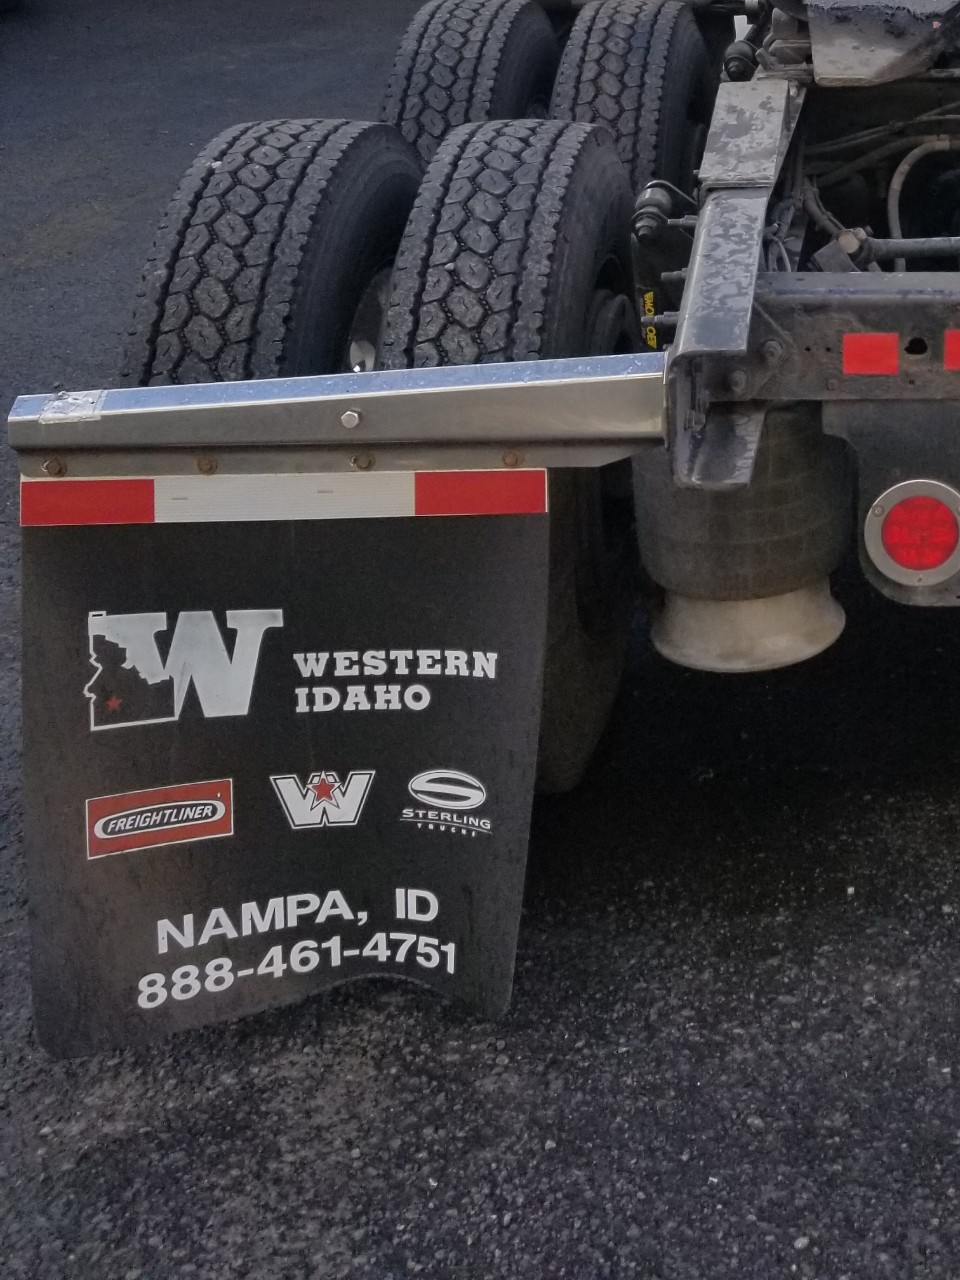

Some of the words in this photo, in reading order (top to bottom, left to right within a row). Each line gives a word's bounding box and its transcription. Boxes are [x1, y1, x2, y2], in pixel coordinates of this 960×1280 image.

[644, 291, 657, 348] MOOE
[292, 649, 498, 680] WESTERN
[294, 684, 431, 713] IDAHO
[107, 805, 214, 834] FREIGHTLINER
[402, 808, 491, 830] STERLING
[156, 889, 368, 954] NAMPA,
[395, 888, 439, 922] ID
[136, 932, 456, 1009] 888-461-4751
